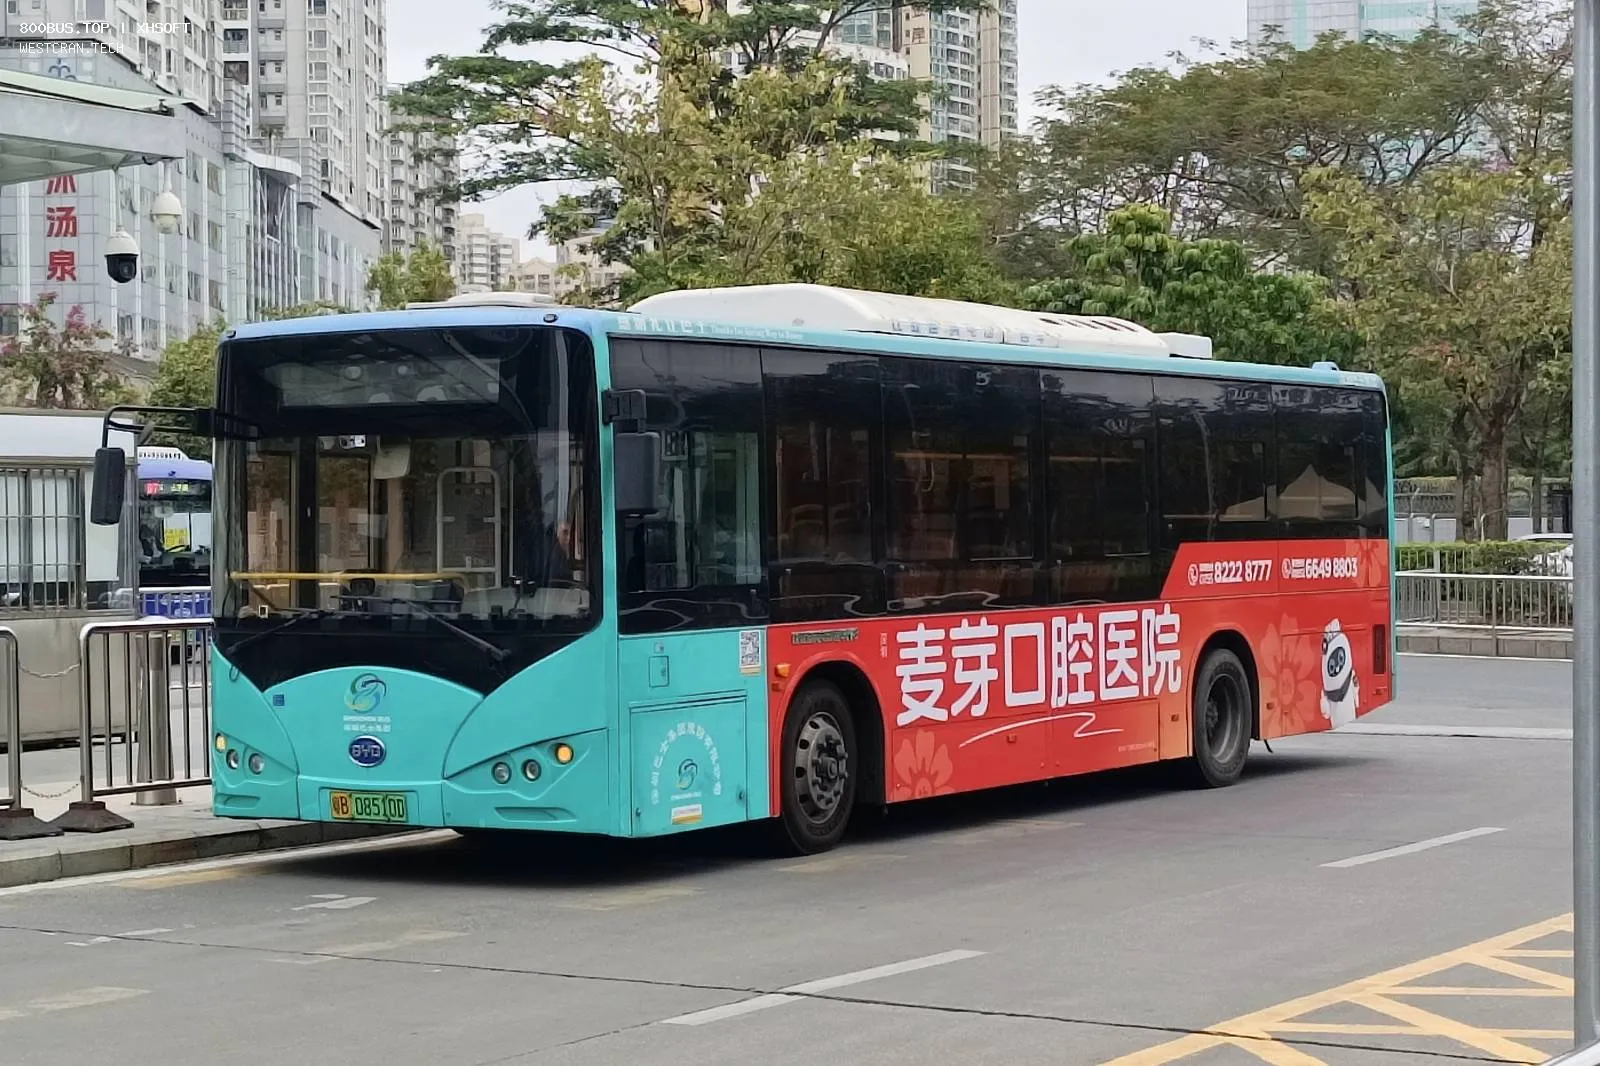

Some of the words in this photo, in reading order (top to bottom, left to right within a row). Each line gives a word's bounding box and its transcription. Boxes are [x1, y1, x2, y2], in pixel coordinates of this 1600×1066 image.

[1214, 561, 1243, 583] 8222
[1245, 560, 1273, 582] 8777
[1305, 558, 1331, 579] 6649
[896, 603, 1182, 726] 麦芽口腔医院
[351, 744, 381, 757] BYD
